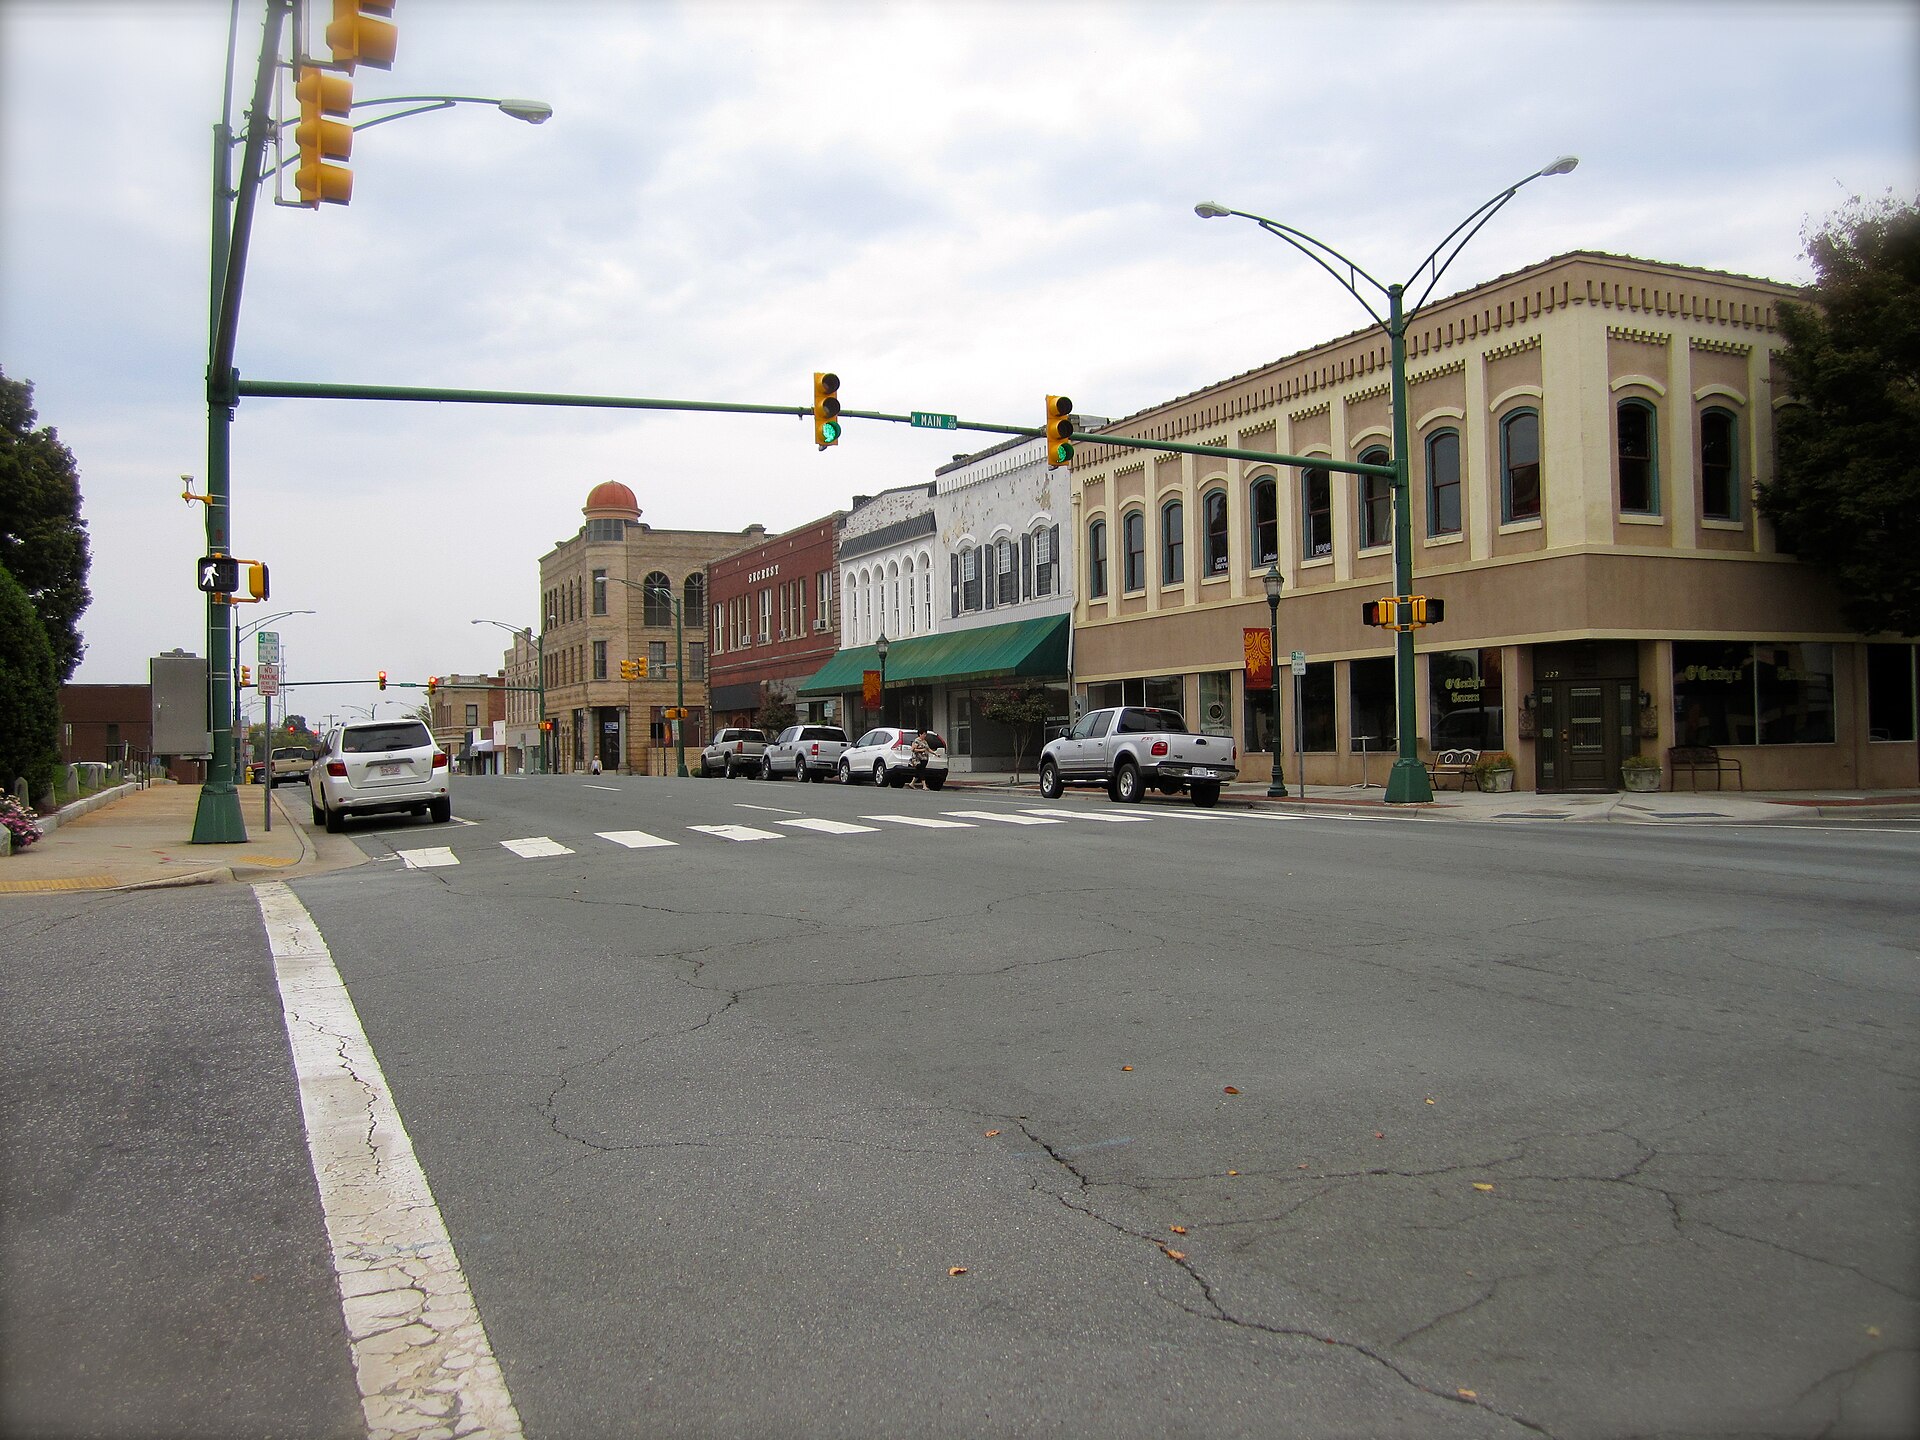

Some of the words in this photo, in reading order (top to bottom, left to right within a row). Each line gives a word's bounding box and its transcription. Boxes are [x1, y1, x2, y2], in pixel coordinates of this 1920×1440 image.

[921, 414, 942, 427] MAIN
[1315, 542, 1331, 554] yoga
[748, 564, 779, 584] SECREST
[259, 633, 265, 643] 2
